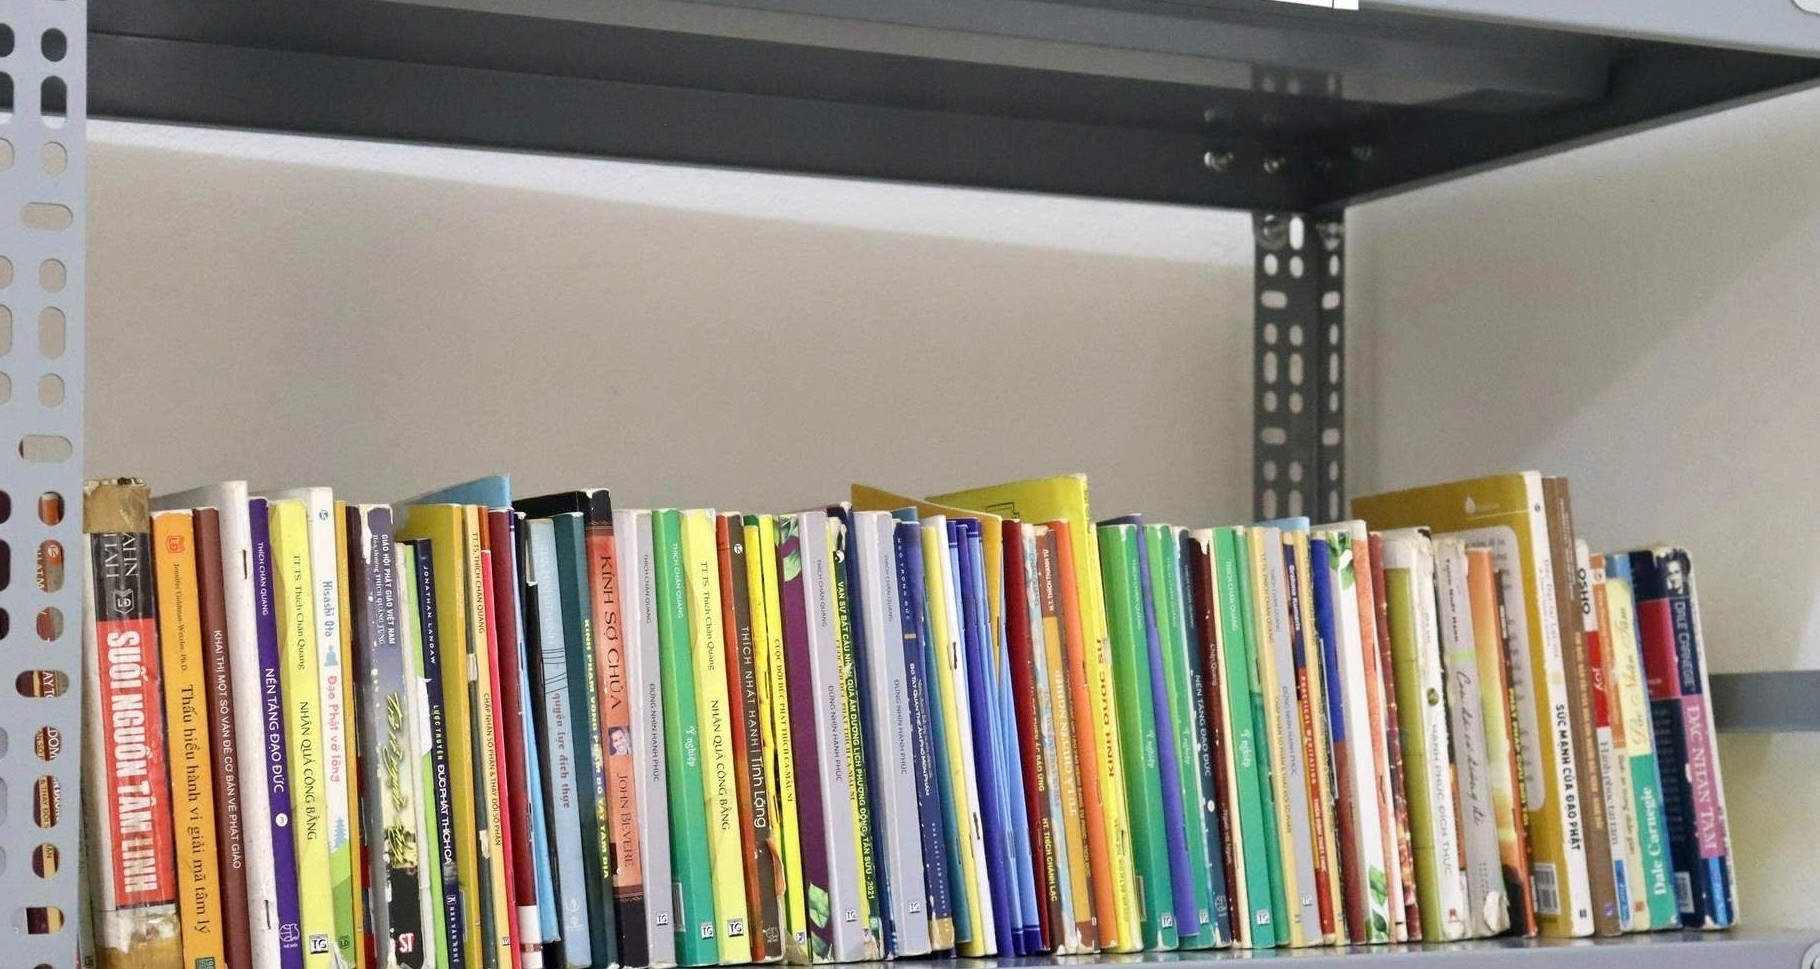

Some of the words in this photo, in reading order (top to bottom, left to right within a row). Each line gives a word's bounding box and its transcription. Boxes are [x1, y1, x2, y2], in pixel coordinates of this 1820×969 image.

[257, 542, 265, 563] THÍCH
[381, 534, 390, 551] GIÁO
[382, 553, 391, 566] HỘI
[473, 556, 481, 579] THÍCH
[423, 565, 432, 618] JONATHAN
[475, 580, 483, 603] CHÂN
[601, 555, 616, 604] KÍNH
[1576, 567, 1591, 615] OSHO
[259, 588, 268, 615] QUANG
[294, 585, 303, 610] Thích
[322, 581, 334, 616] Hisashi
[384, 589, 393, 607] GIÁO
[702, 591, 711, 615] Thích
[295, 612, 304, 636] Chân
[324, 620, 335, 637] Ota
[385, 609, 394, 625] VIỆT
[476, 604, 485, 633] QUANG
[602, 611, 618, 641] SỢ
[704, 616, 713, 640] Chân
[213, 630, 223, 653] KHAI
[387, 628, 395, 644] NAM
[426, 622, 435, 664] LANDAW
[583, 619, 591, 650] KINH
[740, 626, 753, 665] THÍCH
[106, 630, 147, 689] SUỐI
[214, 656, 224, 672] THỊ
[296, 639, 305, 670] Quang
[705, 641, 715, 671] Quang
[264, 667, 277, 694] NỀN
[325, 675, 338, 700] Đạo
[744, 670, 757, 704] NHẤT
[181, 684, 196, 722] Thấu
[266, 695, 281, 730] TẢNG
[327, 704, 339, 730] Phật
[710, 700, 722, 732] NHÂN
[1555, 703, 1569, 727] SỨC
[300, 701, 311, 735] NHÂN
[746, 709, 759, 747] HẠNH
[110, 693, 153, 778] NGUỒN
[183, 728, 198, 759] hiểu
[267, 732, 281, 761] ĐẠO
[712, 734, 726, 760] QUẢ
[1555, 729, 1571, 765] MẠNH
[224, 756, 233, 773] CƠ
[300, 739, 315, 765] QUẢ
[1105, 731, 1114, 777] KINH
[186, 766, 201, 801] hành
[271, 763, 285, 793] ĐỨC
[303, 768, 316, 803] CÔNG
[436, 764, 446, 788] ĐỨC
[617, 772, 630, 809] JOHN
[715, 762, 728, 795] CÔNG
[1562, 766, 1577, 791] CỦA
[117, 779, 157, 834] TÂM
[190, 808, 200, 820] vi
[438, 788, 449, 815] PHẬT
[718, 798, 733, 830] BẰNG
[751, 790, 767, 828] Lặng
[1562, 793, 1577, 820] ĐẠO
[305, 806, 320, 840] BẰNG
[441, 816, 452, 848] THÍCH
[1640, 786, 1662, 856] Carnegie
[187, 826, 202, 853] giải
[620, 812, 633, 868] BEVERE
[1043, 831, 1053, 855] THÍCH
[121, 837, 157, 893] LINH
[192, 859, 204, 881] mã
[231, 843, 242, 869] GIÁO
[443, 848, 452, 863] CA
[866, 880, 874, 899] 2021
[1650, 858, 1667, 894] Dale
[194, 887, 207, 915] tâm
[193, 920, 209, 933] lý
